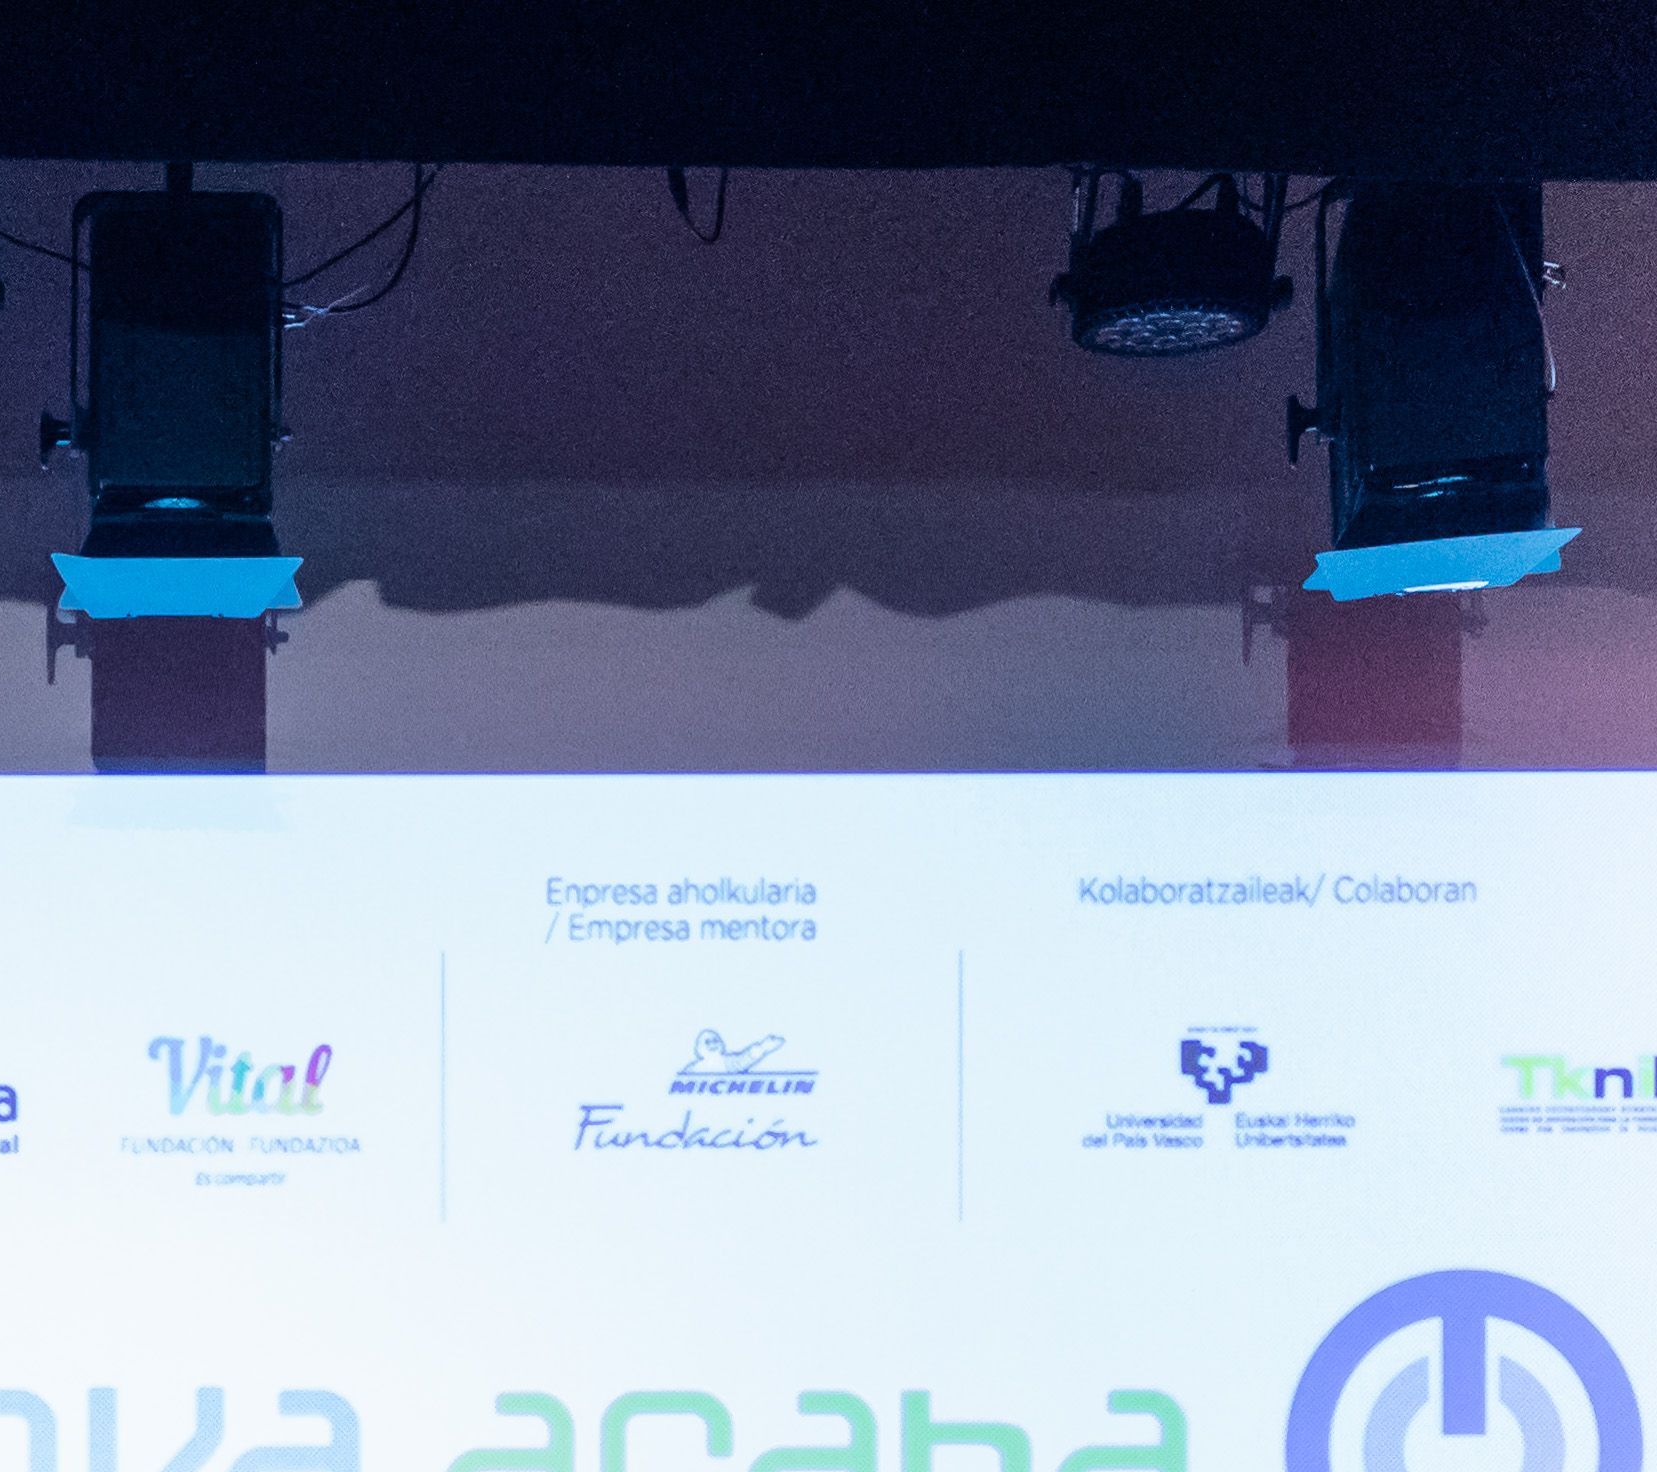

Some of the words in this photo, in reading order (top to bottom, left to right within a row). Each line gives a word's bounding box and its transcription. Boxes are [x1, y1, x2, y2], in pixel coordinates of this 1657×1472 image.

[546, 876, 658, 908] Enpresa
[667, 878, 817, 906] aholkularia
[1333, 875, 1477, 904] Colaboran
[569, 913, 690, 945] Empresa
[701, 915, 817, 941] mentora
[148, 1036, 333, 1116] Vital
[670, 1079, 814, 1095] MICHELIN
[575, 1104, 817, 1150] Fundación
[1107, 1115, 1203, 1129] Universidad
[122, 1136, 234, 1154] FUNDACIÓN
